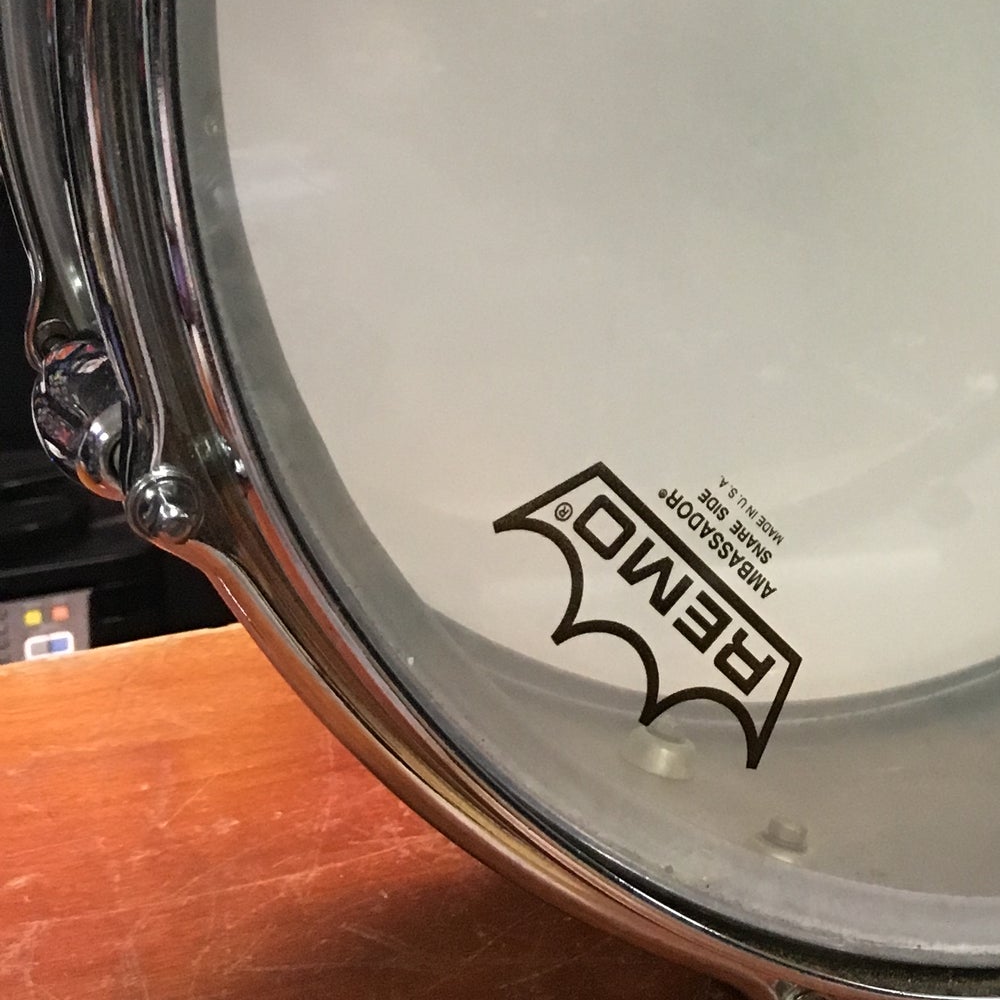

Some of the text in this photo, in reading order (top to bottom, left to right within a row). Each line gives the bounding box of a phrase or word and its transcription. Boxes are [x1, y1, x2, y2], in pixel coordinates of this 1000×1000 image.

[697, 488, 773, 565] SNARE SIDE
[745, 505, 759, 520] IN
[755, 515, 784, 546] MADE
